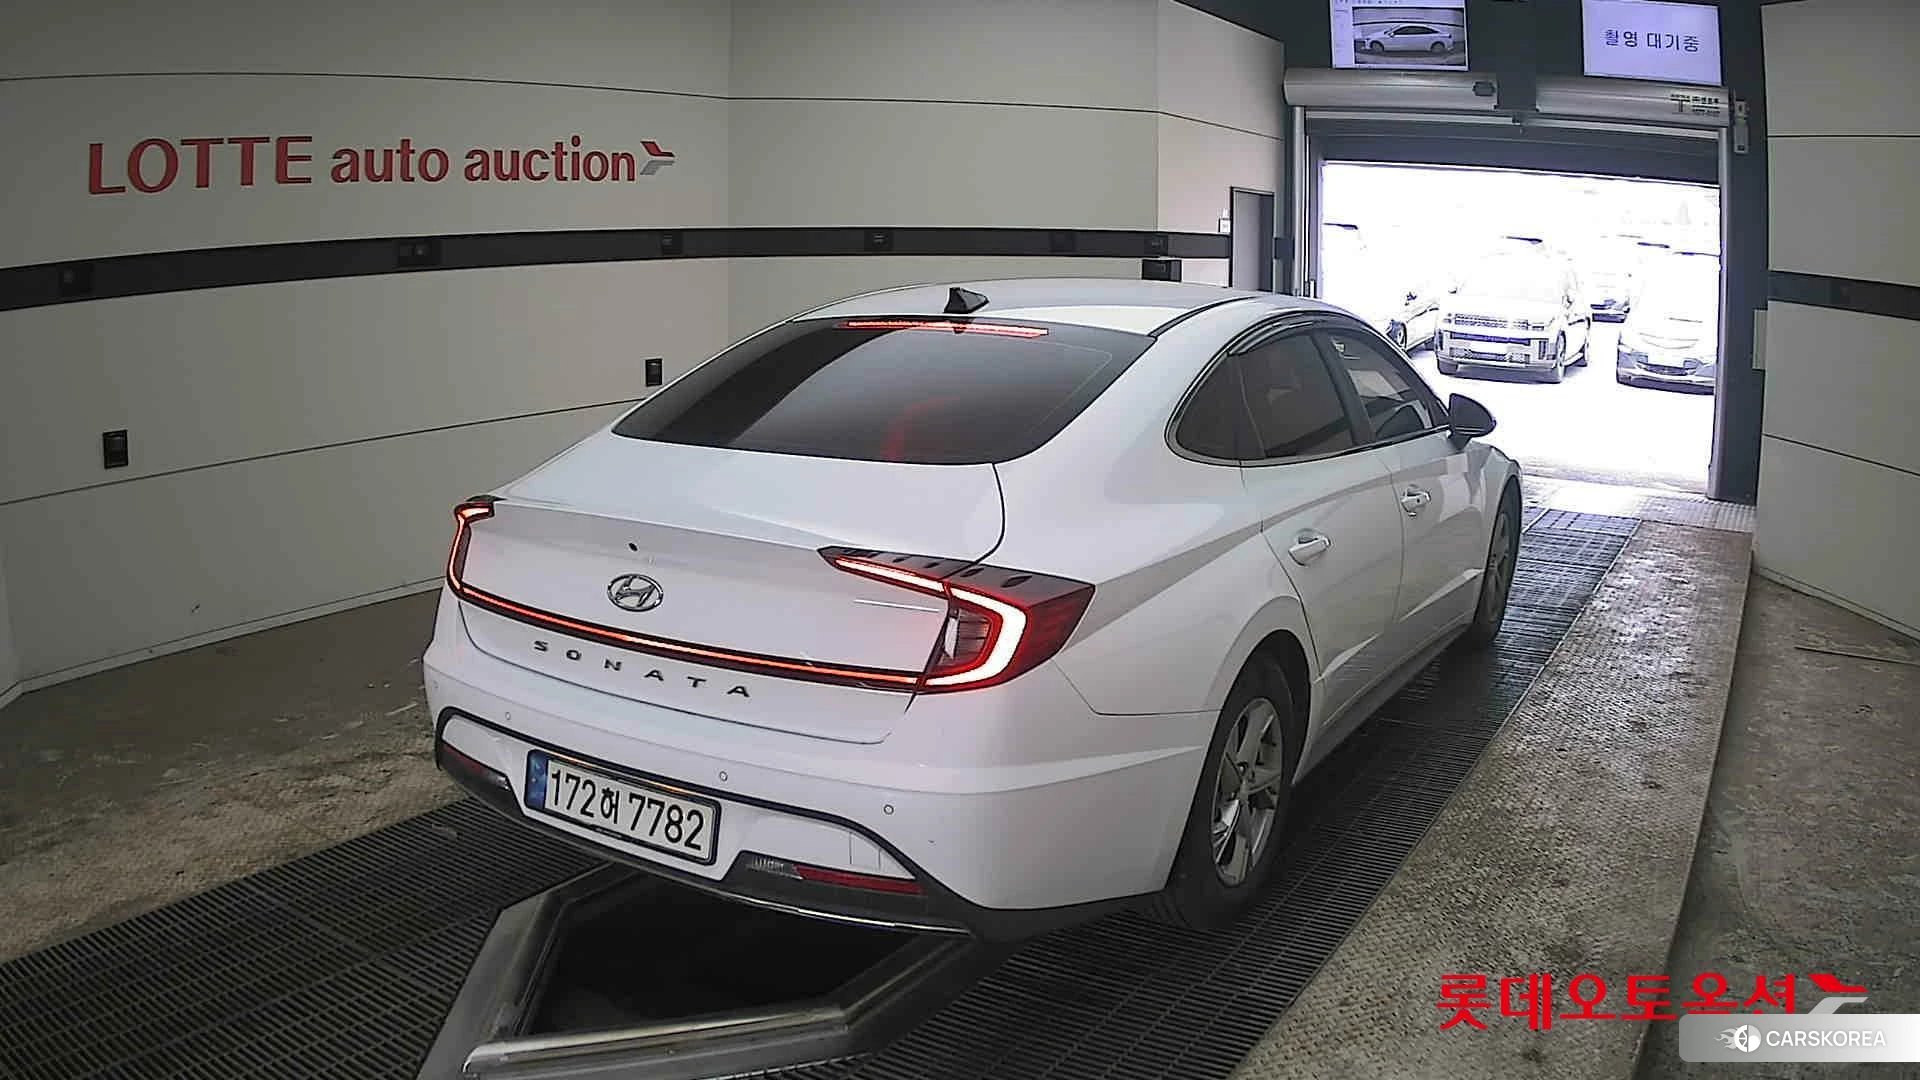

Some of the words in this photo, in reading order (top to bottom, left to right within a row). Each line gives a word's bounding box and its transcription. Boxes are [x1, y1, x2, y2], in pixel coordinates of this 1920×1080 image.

[1646, 32, 1700, 52] 대기중
[88, 135, 313, 195] LOTTE
[330, 138, 449, 184] auto
[463, 135, 637, 183] auction
[533, 639, 751, 698] SONATA
[551, 769, 620, 825] 172허
[628, 791, 705, 851] 7782
